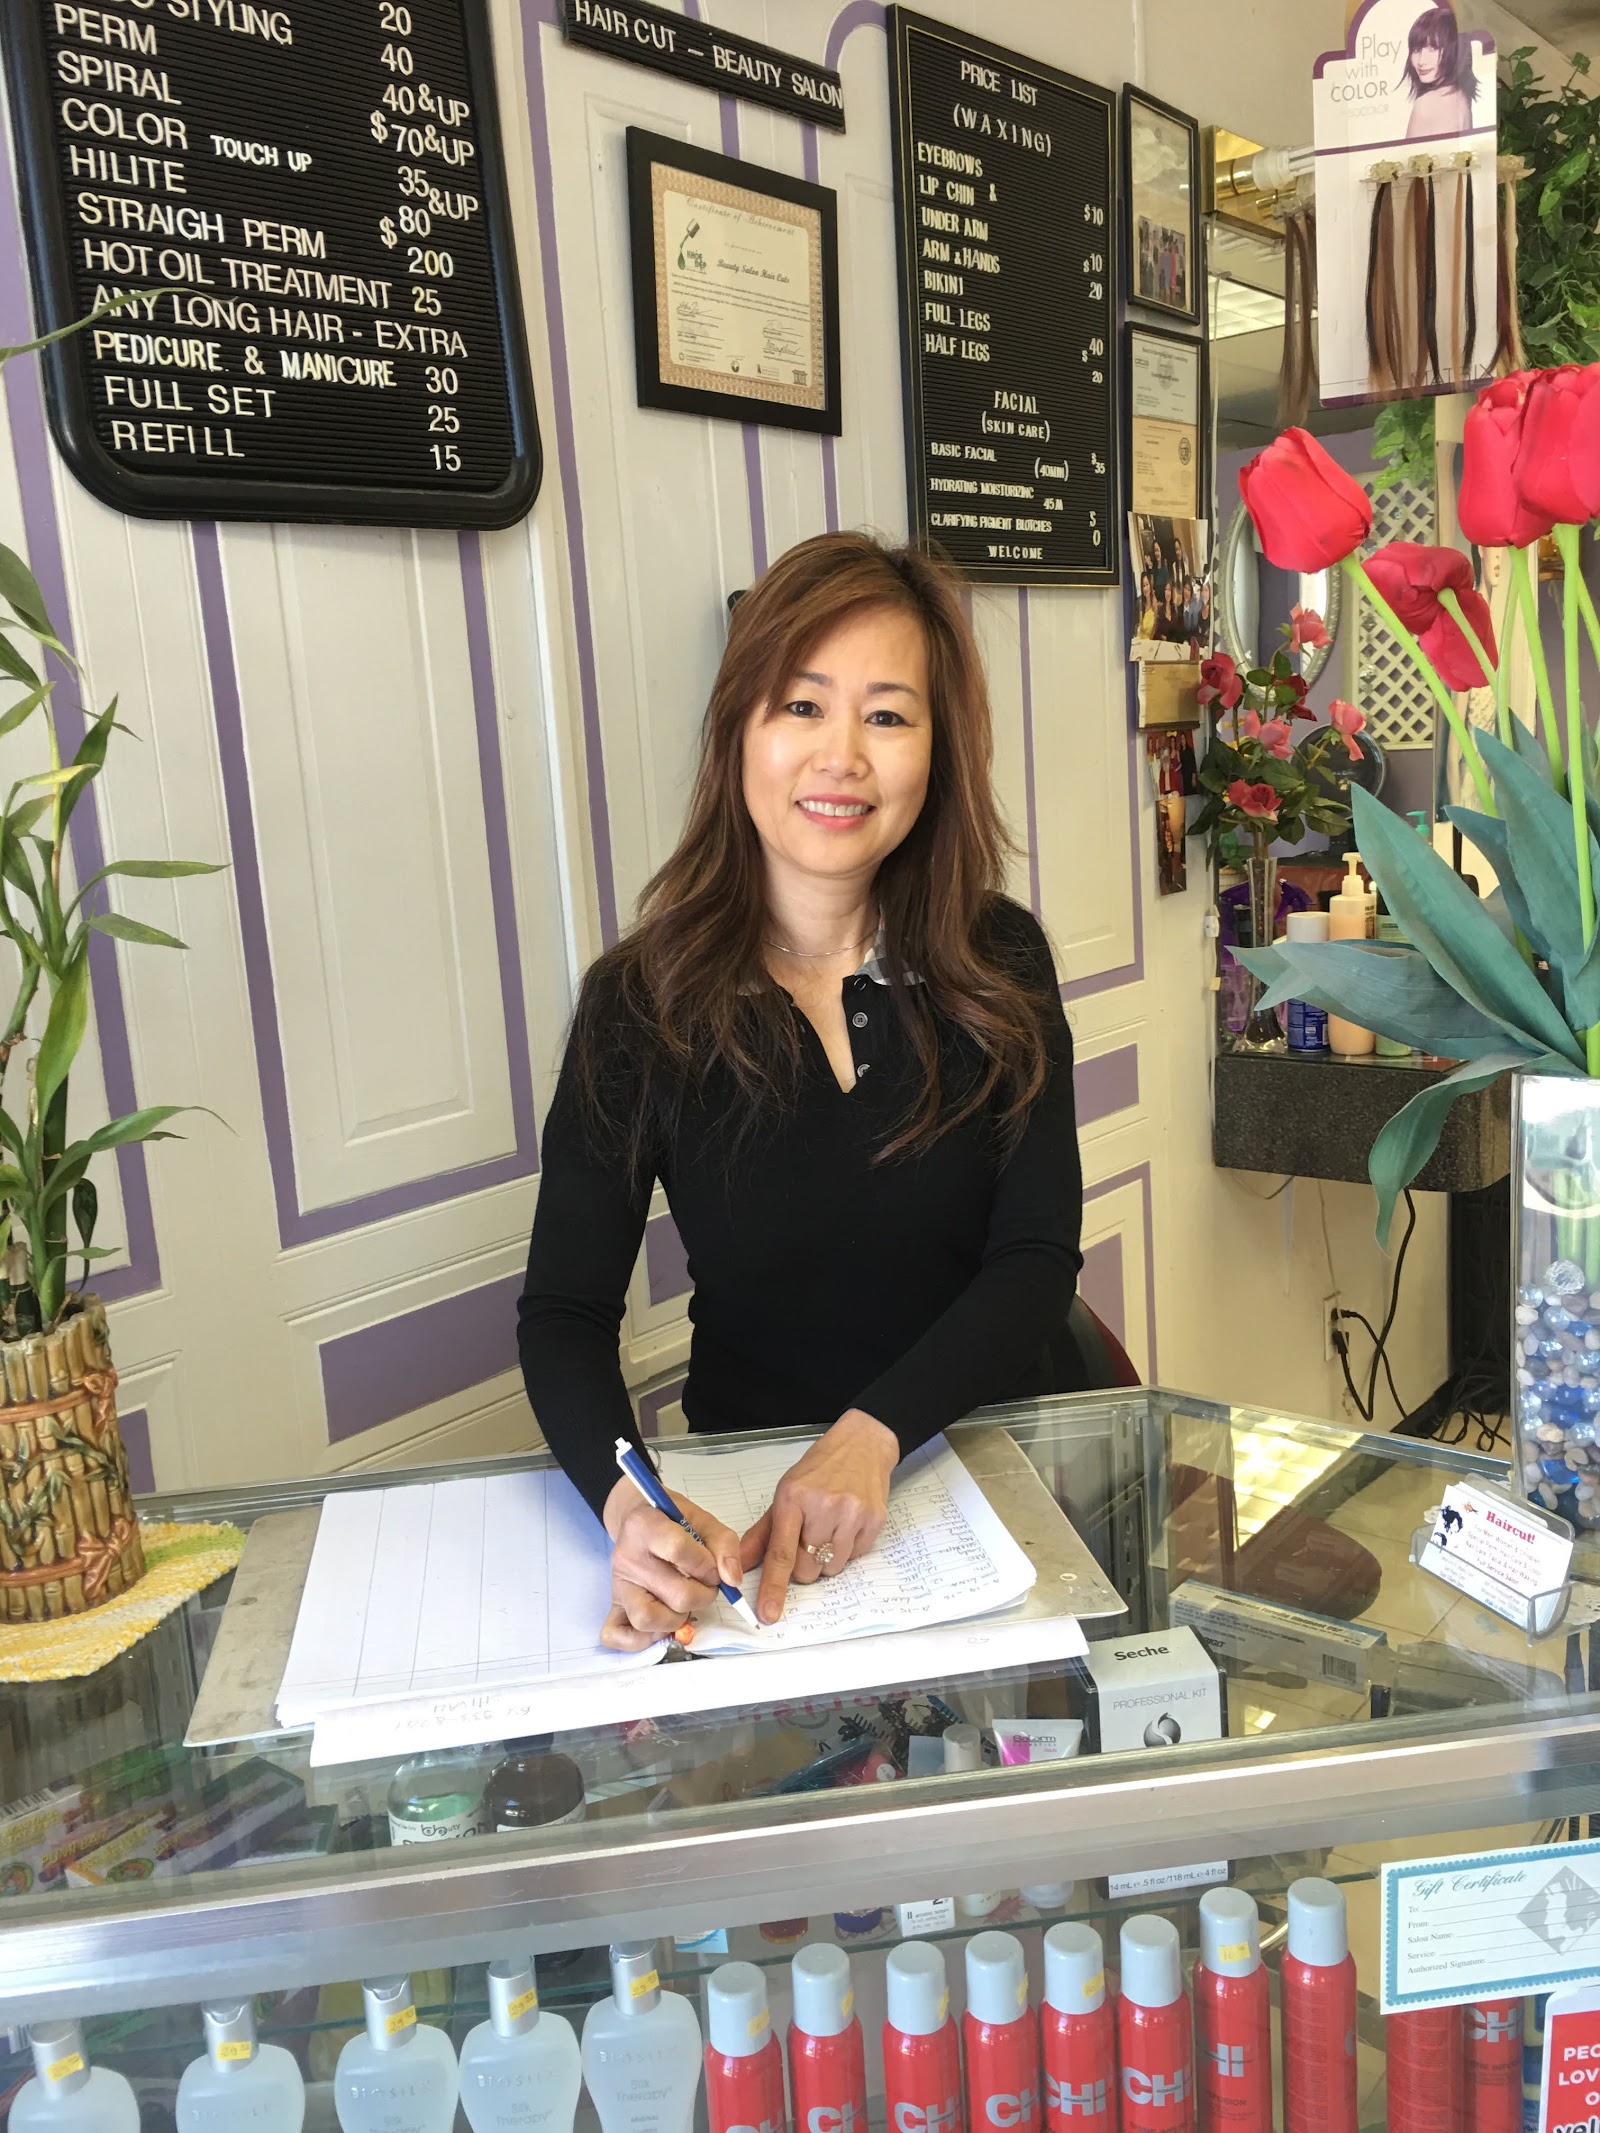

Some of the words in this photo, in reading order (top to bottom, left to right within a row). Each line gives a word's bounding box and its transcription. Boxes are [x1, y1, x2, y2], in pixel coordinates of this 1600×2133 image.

[54, 3, 157, 55] PERM
[379, 2, 411, 35] 20
[381, 43, 413, 75] 40
[575, 0, 629, 38] HAIR
[634, 19, 676, 52] CUT
[712, 45, 782, 88] BEAUTY
[791, 72, 843, 109] SALON
[1361, 34, 1402, 64] Play
[57, 50, 182, 105] SPIRAL
[960, 60, 1001, 93] PRICE
[1010, 79, 1038, 106] LIST
[1345, 62, 1378, 80] with
[1330, 80, 1388, 102] COLOR
[62, 98, 188, 149] COLOR
[210, 134, 279, 167] TOUCH
[287, 150, 312, 172] UP
[70, 145, 187, 193] HILITE
[917, 141, 983, 177] EYEBROWS
[919, 174, 939, 196] LIP
[946, 181, 974, 206] CHIN
[989, 183, 997, 201] &
[921, 206, 959, 233] UNDER
[964, 217, 989, 242] ARM
[1084, 204, 1103, 226] $10
[77, 192, 224, 242] STRAIGH
[243, 218, 326, 259] PERM
[407, 246, 453, 278] 200
[922, 238, 949, 262] ARM
[83, 238, 153, 276] HOT
[159, 249, 215, 284] OIL
[221, 257, 392, 309] TREATMENT
[412, 286, 441, 316] 25
[924, 270, 964, 295] BIKINI
[1089, 282, 1102, 300] 20
[92, 283, 158, 321] ANY
[172, 294, 260, 333] LONG
[268, 307, 344, 343] HAIR
[375, 319, 468, 358] EXTRA
[925, 302, 955, 325] FULL
[960, 308, 990, 331] LEGS
[925, 333, 957, 356] HALF
[961, 339, 990, 362] LEGS
[244, 345, 265, 375] &
[279, 350, 397, 389] MANICURE
[425, 366, 458, 395] 30
[1092, 371, 1103, 383] 20
[104, 375, 193, 411] FULL
[207, 384, 276, 418] SET
[428, 405, 460, 433] 25
[994, 390, 1039, 414] FACIAL
[111, 420, 245, 457] REFILL
[429, 444, 461, 472] 15
[931, 442, 961, 458] BASIC
[964, 446, 997, 462] FACIAL
[930, 477, 978, 494] HYDRATING
[931, 513, 978, 528] CLARIFYING
[980, 516, 1012, 531] PIGMENT
[1015, 518, 1052, 532] BLOTCHES
[1486, 1511, 1535, 1544] Haircut!
[1113, 1643, 1169, 1661] Seche
[1113, 1690, 1189, 1710] PROFESSIONAL
[1192, 1687, 1207, 1698] KIT
[1412, 1878, 1444, 1900] Gift
[1451, 1870, 1527, 1892] Certificate
[1407, 1935, 1428, 1943] Salon
[1408, 1962, 1447, 1974] Authorized
